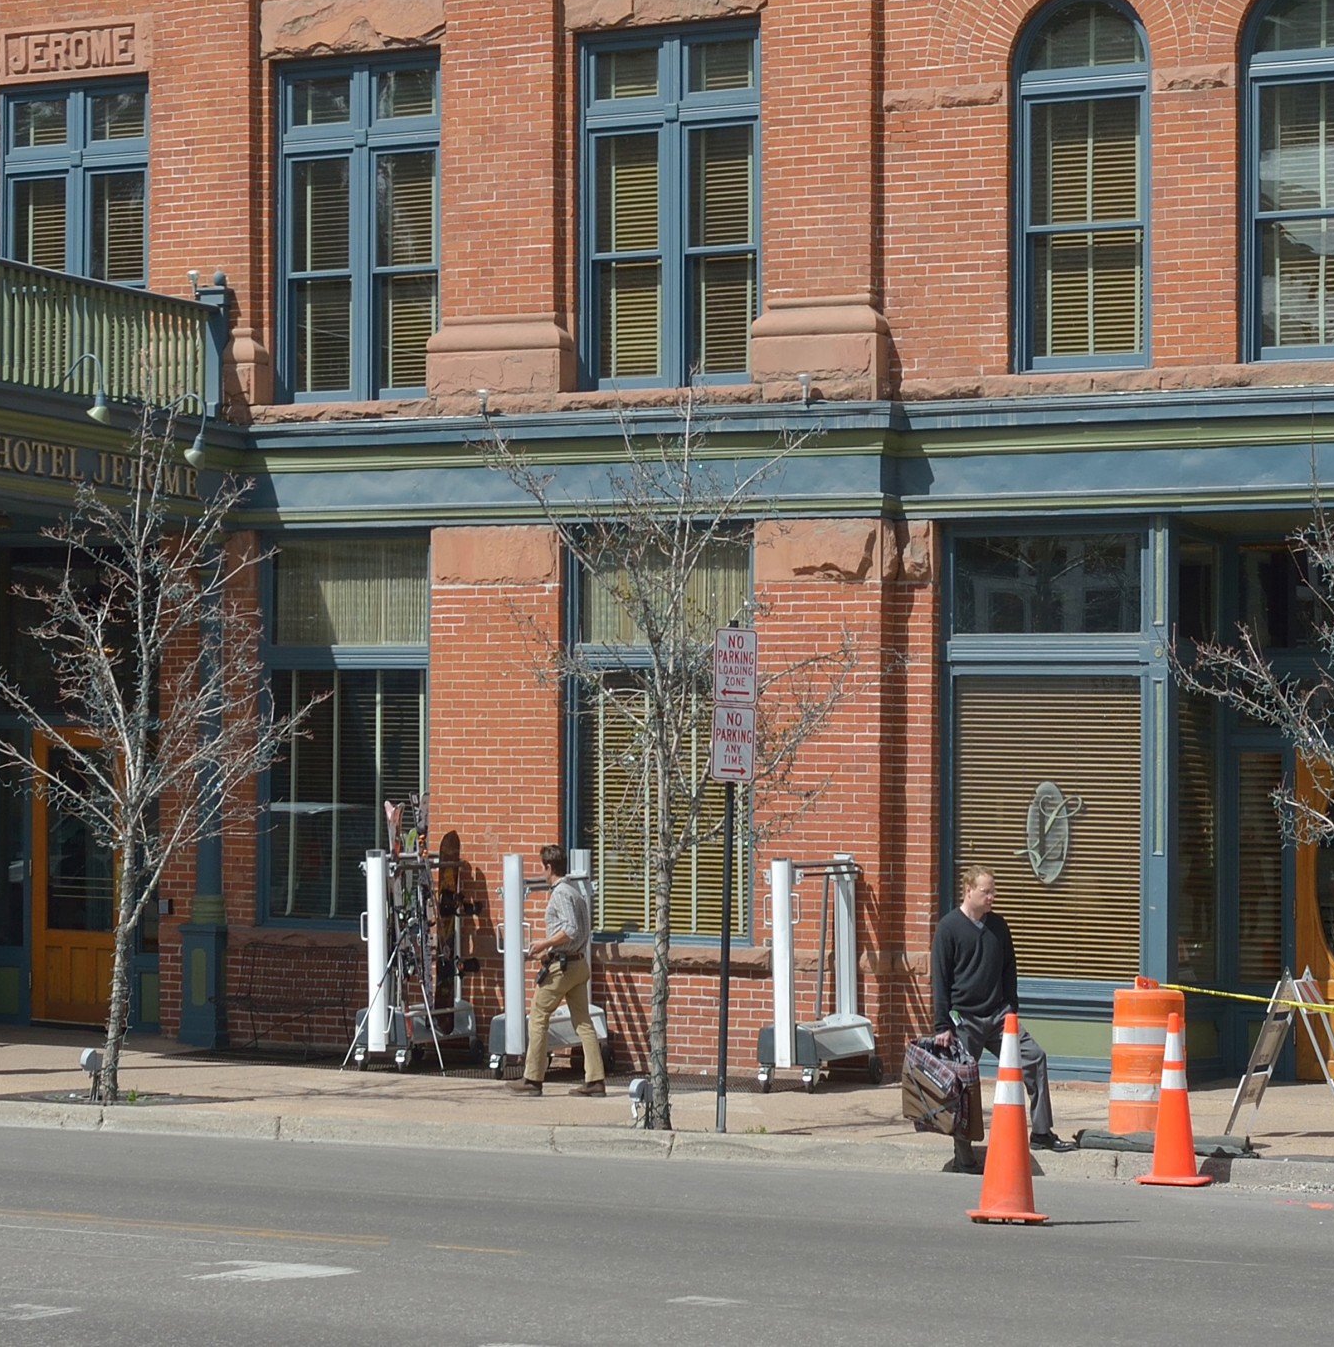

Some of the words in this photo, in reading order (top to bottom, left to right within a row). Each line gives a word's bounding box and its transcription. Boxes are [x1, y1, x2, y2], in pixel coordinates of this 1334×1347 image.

[8, 26, 134, 74] JEROME
[93, 452, 199, 498] JEROME
[728, 635, 744, 648] NO
[718, 650, 754, 665] PARKING
[718, 665, 753, 676] LOADING
[725, 676, 746, 687] ZONE
[726, 712, 742, 726] NO
[716, 728, 752, 744] PARKING
[725, 744, 741, 753] ANY
[723, 755, 743, 766] TIME
